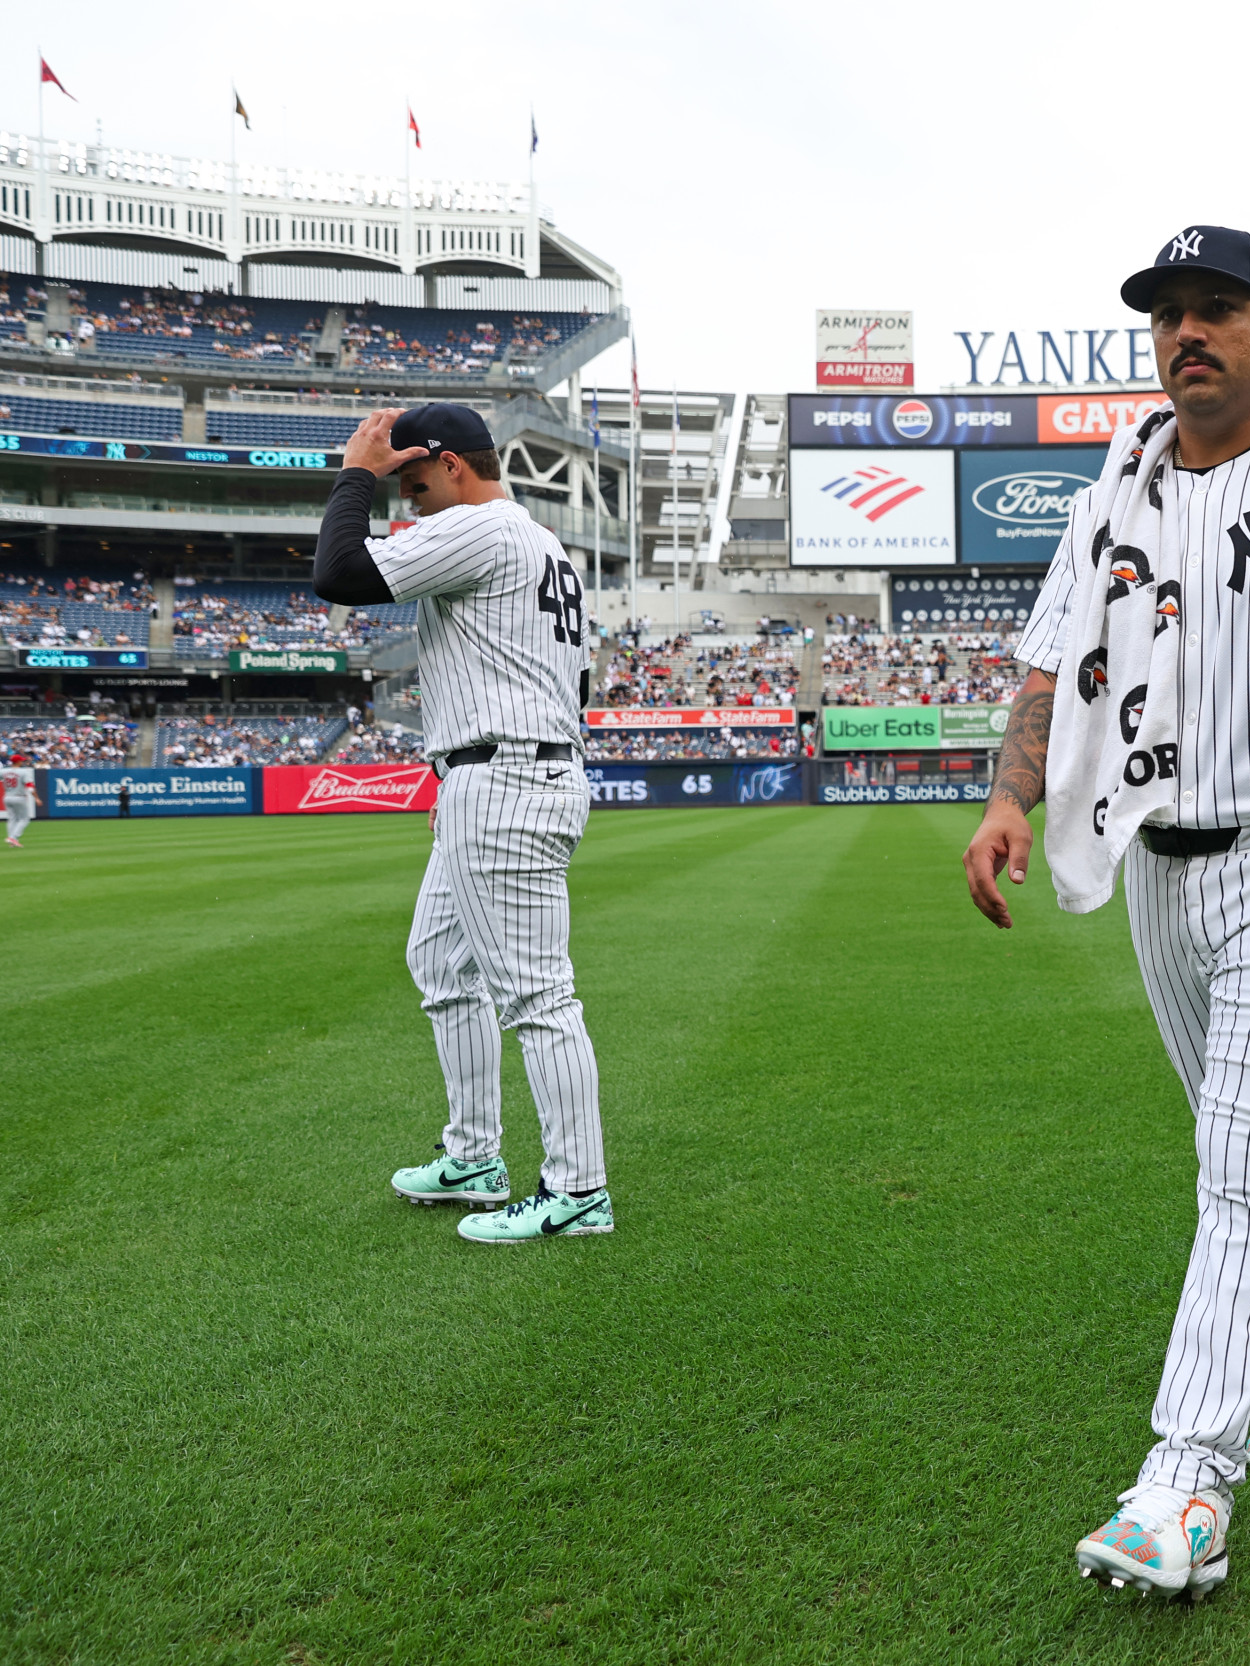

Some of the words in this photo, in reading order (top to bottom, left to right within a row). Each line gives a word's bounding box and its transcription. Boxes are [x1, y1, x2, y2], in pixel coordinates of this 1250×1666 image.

[819, 317, 910, 329] ARMITRON
[953, 329, 1153, 386] YANKE
[824, 363, 906, 377] ARMITRON
[862, 376, 904, 384] WATCHES
[813, 411, 872, 426] PEPSI
[896, 415, 930, 424] PEPSI
[954, 411, 1012, 426] PEPSI
[1052, 399, 1161, 434] GATO
[185, 450, 229, 463] NESTOR
[249, 450, 327, 469] CORTES
[796, 537, 842, 549] BANK
[847, 537, 868, 548] OF
[873, 536, 950, 548] AMERICA
[538, 553, 582, 648] 48
[26, 654, 89, 667] CORTES
[239, 652, 286, 670] Poland
[288, 652, 337, 671] Spring
[829, 720, 879, 738] Uber
[884, 719, 936, 737] Eats
[55, 776, 166, 795] Montefiore
[170, 776, 246, 794] Einstein
[310, 776, 418, 798] Budweiser
[681, 774, 713, 794] 65
[824, 785, 889, 801] StubHub
[895, 784, 958, 800] StubHub
